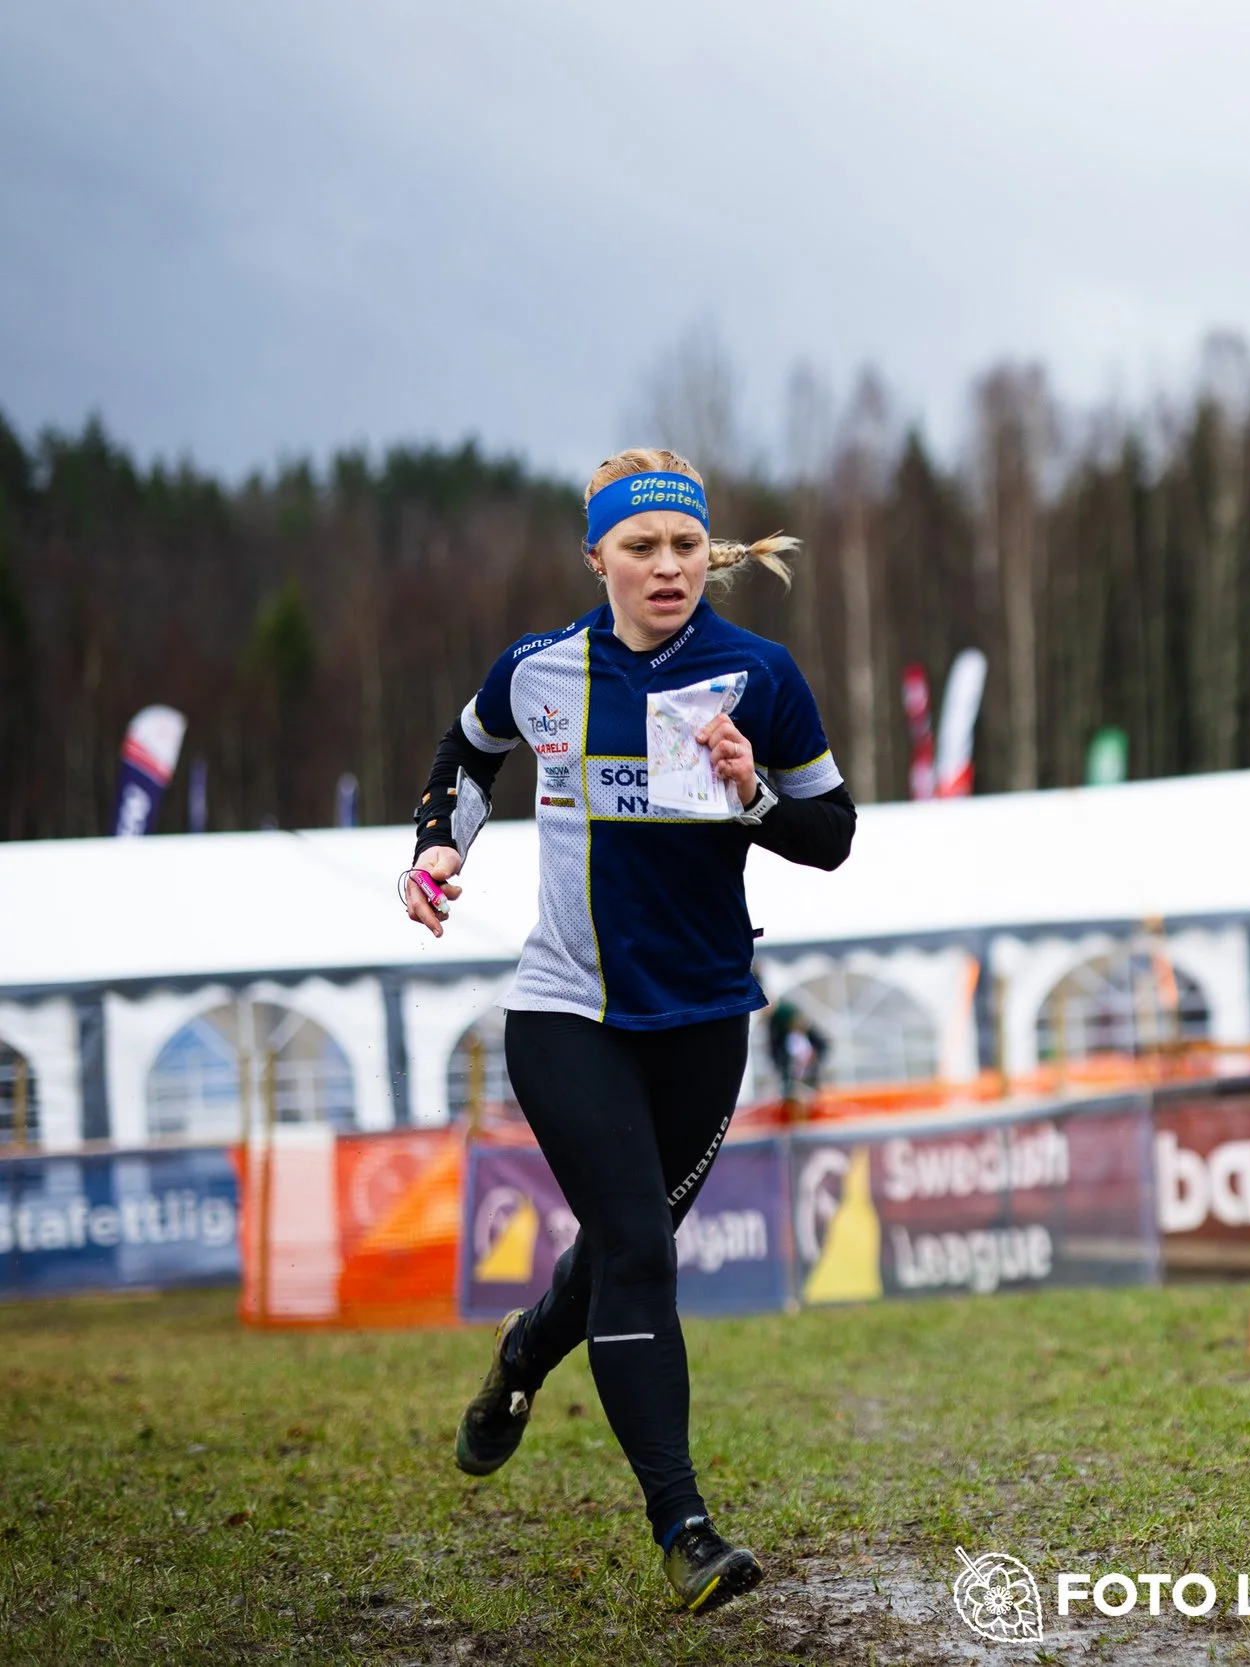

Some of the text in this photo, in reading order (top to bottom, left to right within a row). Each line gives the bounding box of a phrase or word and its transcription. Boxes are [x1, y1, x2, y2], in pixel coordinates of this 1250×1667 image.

[630, 477, 696, 495] Offensiv
[512, 622, 576, 659] nonae
[650, 624, 695, 669] noname
[528, 714, 570, 736] Telge
[600, 764, 648, 787] SÖD
[617, 796, 658, 814] NY
[883, 1125, 1070, 1201] Swedish
[891, 1224, 1053, 1295] League
